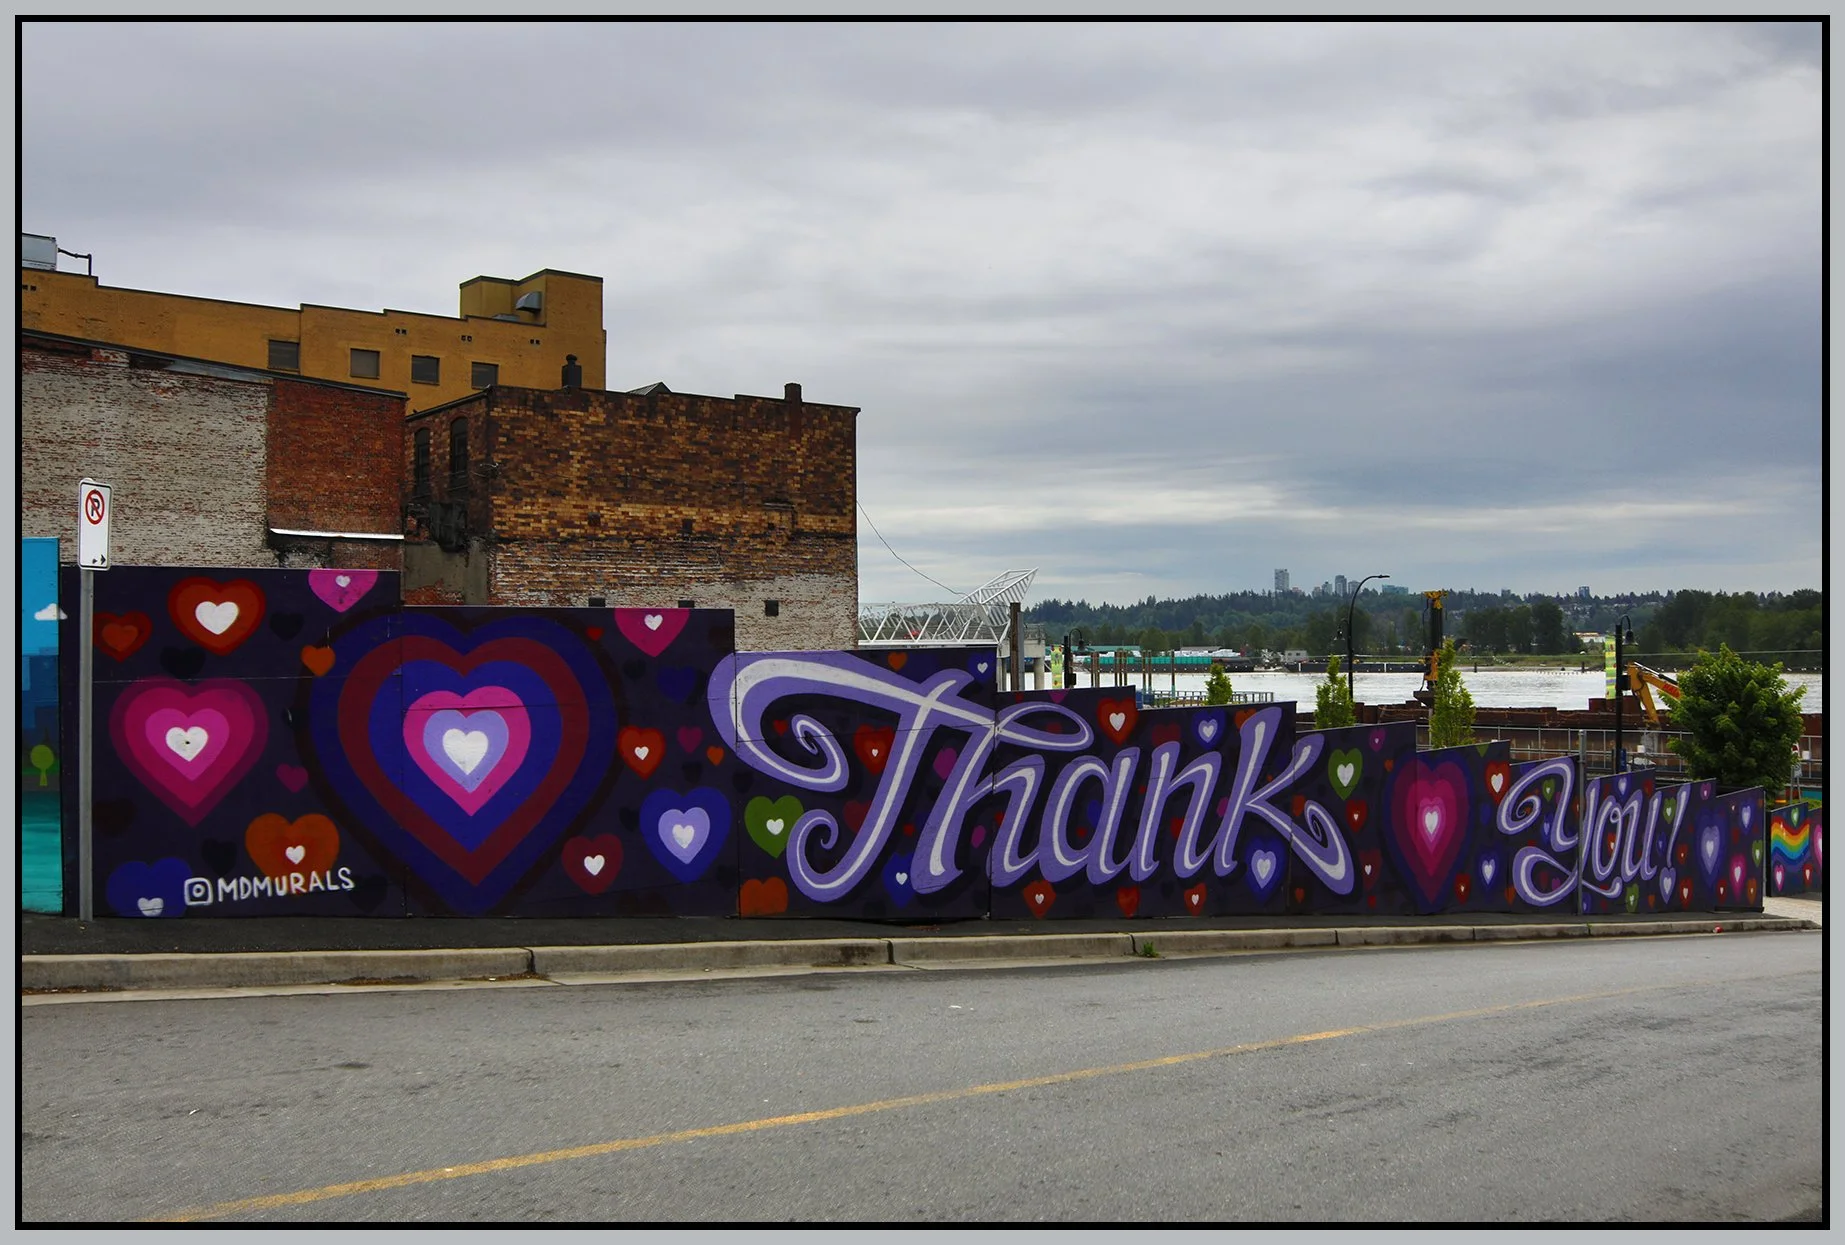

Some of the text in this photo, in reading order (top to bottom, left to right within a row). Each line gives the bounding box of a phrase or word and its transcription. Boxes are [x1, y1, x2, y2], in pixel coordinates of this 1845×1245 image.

[708, 650, 1691, 907] Thank You!
[218, 867, 355, 902] MDMURALS
